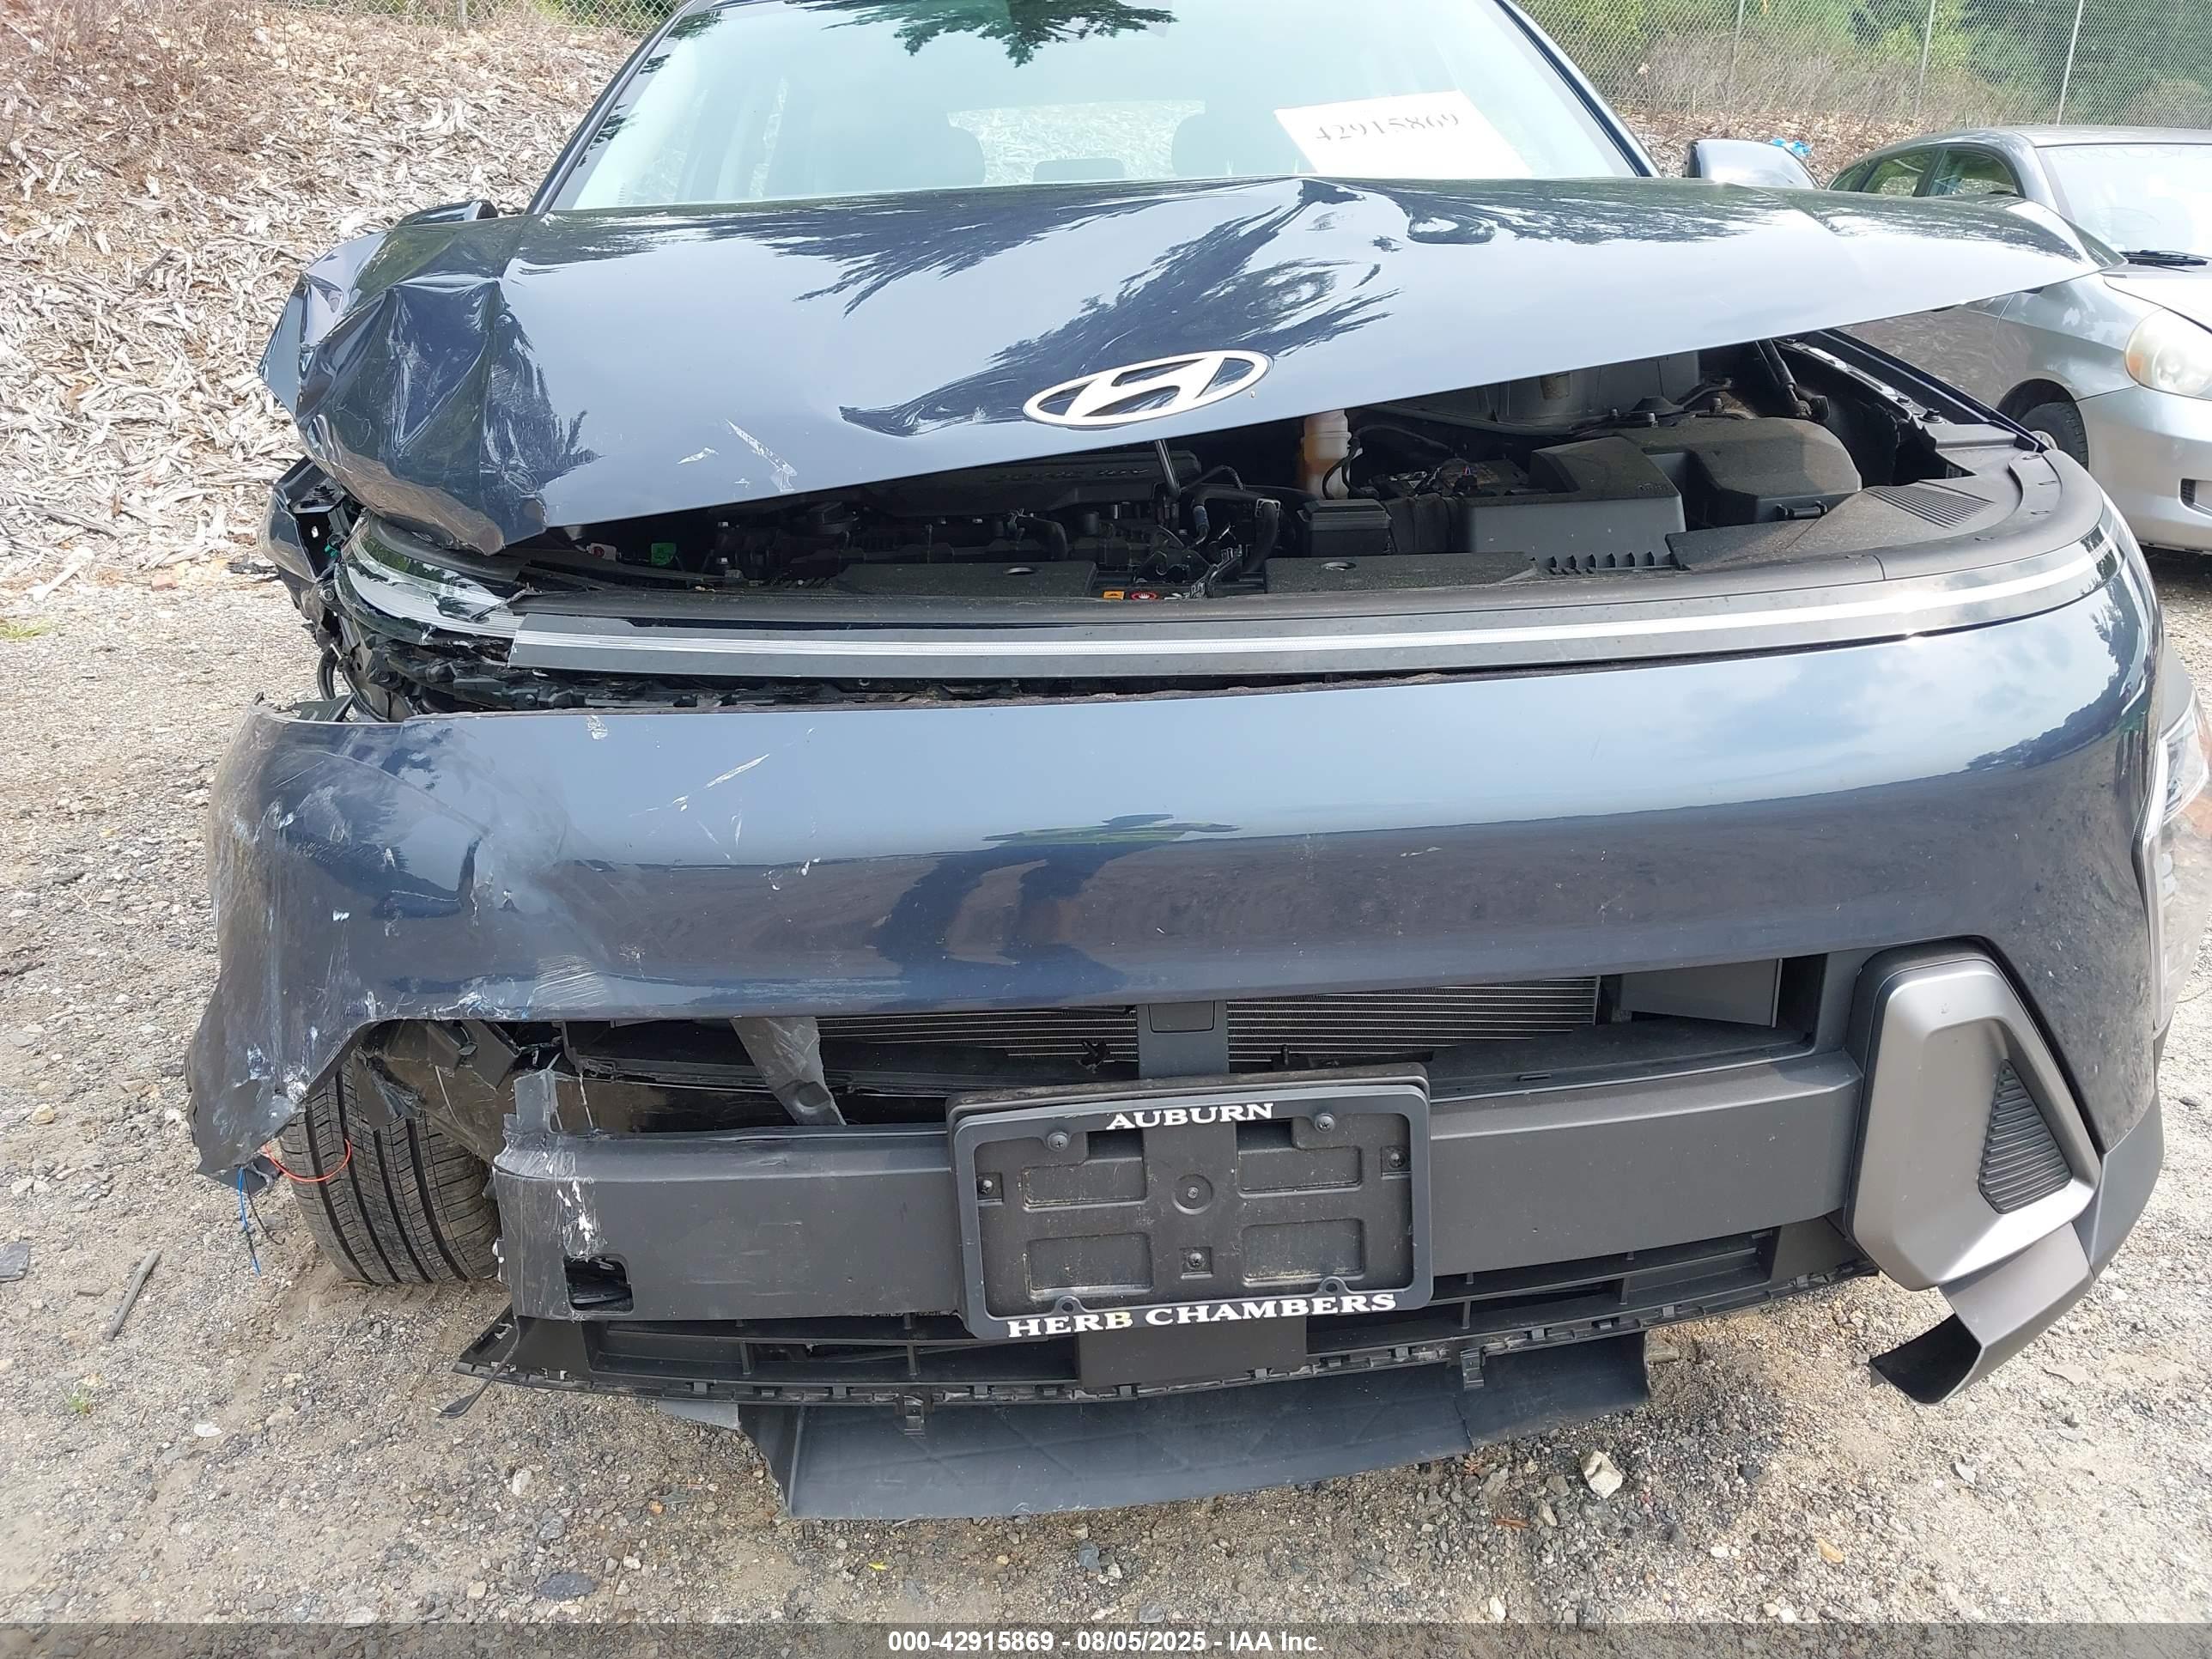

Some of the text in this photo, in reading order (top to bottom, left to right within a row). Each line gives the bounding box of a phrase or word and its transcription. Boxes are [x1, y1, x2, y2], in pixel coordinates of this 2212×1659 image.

[1105, 1102, 1275, 1130] AUBURN
[1006, 1292, 1397, 1338] HERB CHAMBERS
